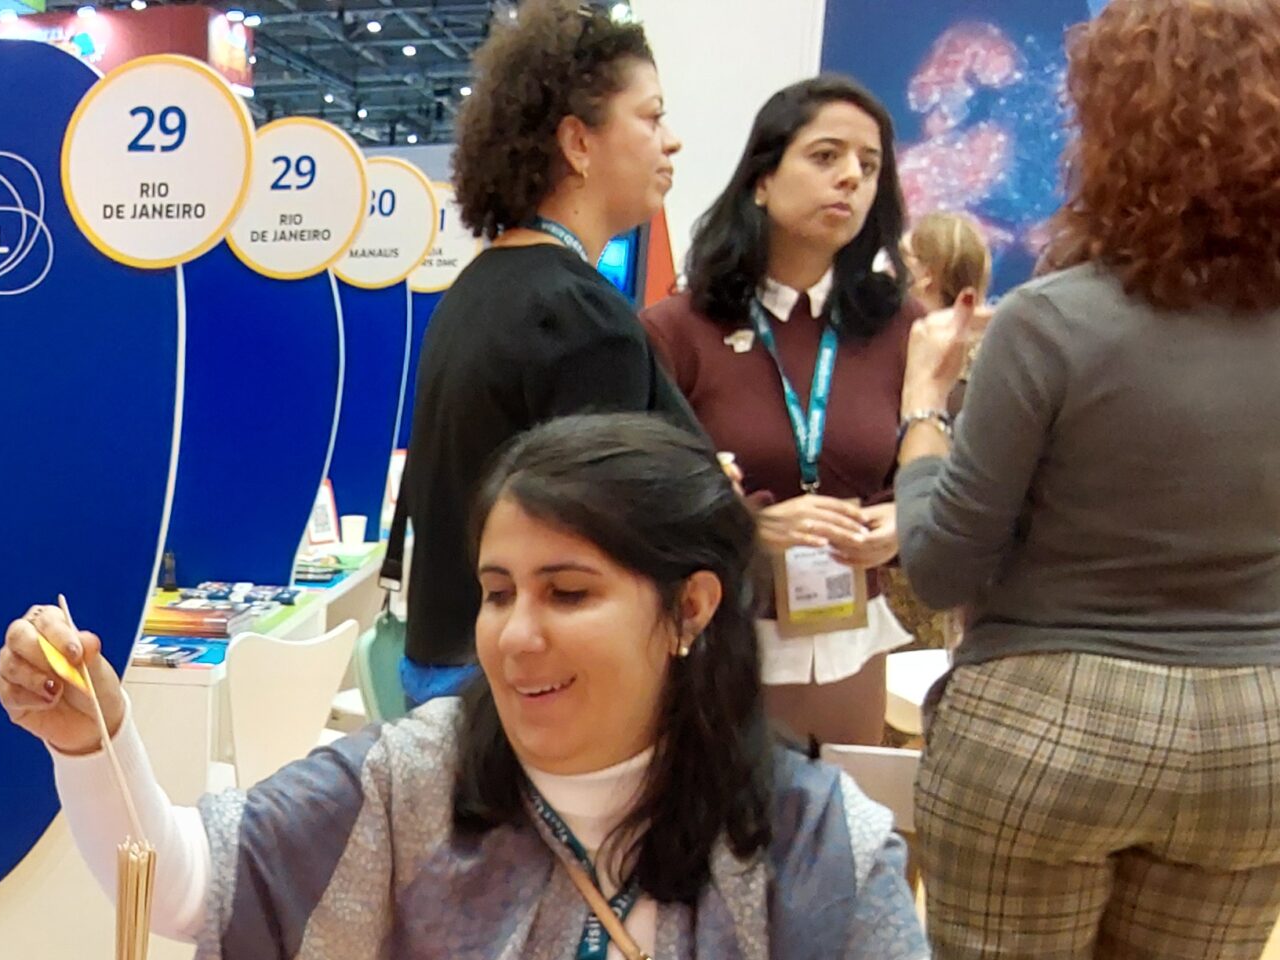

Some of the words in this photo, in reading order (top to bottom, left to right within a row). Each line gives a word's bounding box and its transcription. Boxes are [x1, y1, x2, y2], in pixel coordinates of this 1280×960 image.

[127, 105, 187, 152] 29
[270, 155, 316, 190] 29
[140, 182, 169, 198] RIO
[103, 204, 125, 220] DE
[130, 203, 205, 219] JANEIRO
[279, 214, 303, 226] RIO
[250, 230, 268, 243] DE
[272, 229, 332, 242] JANEIRO
[349, 248, 400, 259] MANAUS
